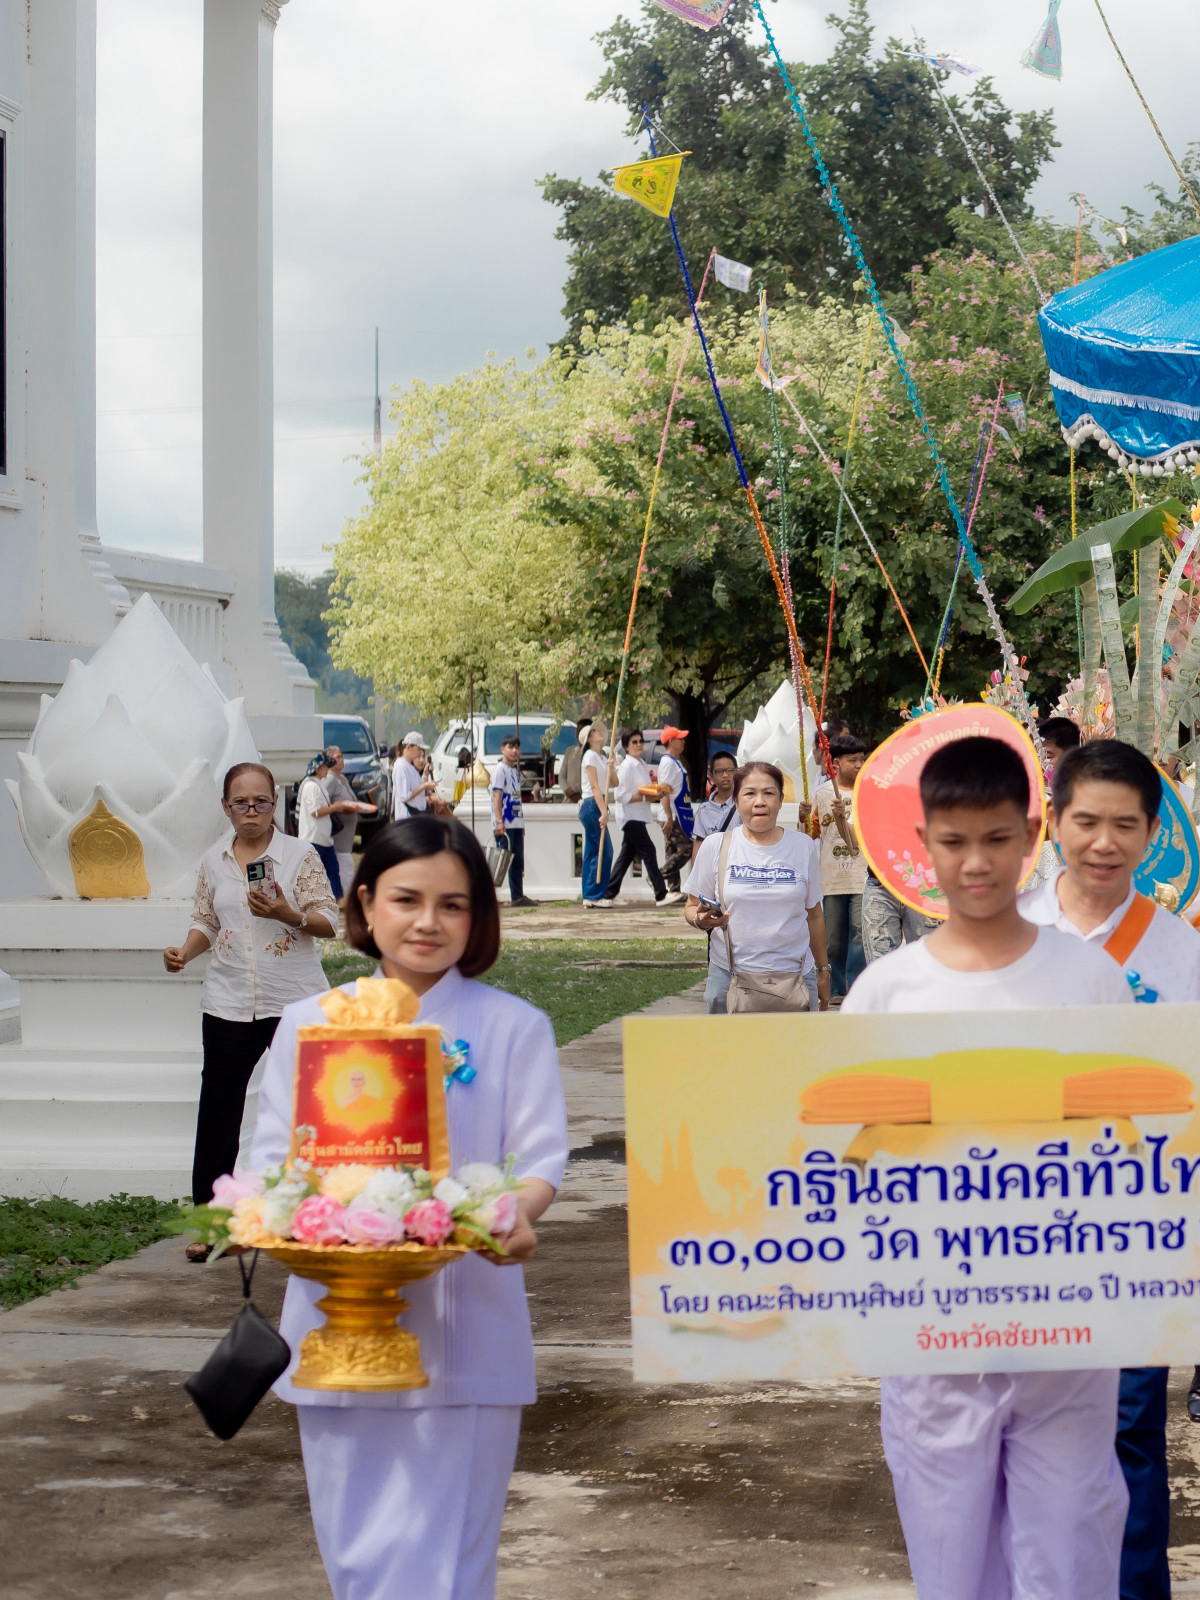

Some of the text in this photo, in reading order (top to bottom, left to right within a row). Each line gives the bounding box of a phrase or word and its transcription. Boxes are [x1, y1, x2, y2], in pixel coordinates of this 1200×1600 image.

[733, 866, 792, 884] Wrangler
[670, 1236, 846, 1272] ๓๐,๐๐๐
[861, 1215, 919, 1260] วัด
[934, 1208, 1186, 1276] พุทธศักราช
[660, 1285, 709, 1315] โดย
[717, 1278, 924, 1318] คณะศิษยานุศิษย์
[932, 1283, 1051, 1316] บูชาธรรม
[1058, 1283, 1093, 1302] ๘๑
[1099, 1272, 1119, 1300] ปี
[916, 1321, 1092, 1351] จังหวัดชัยนาท
